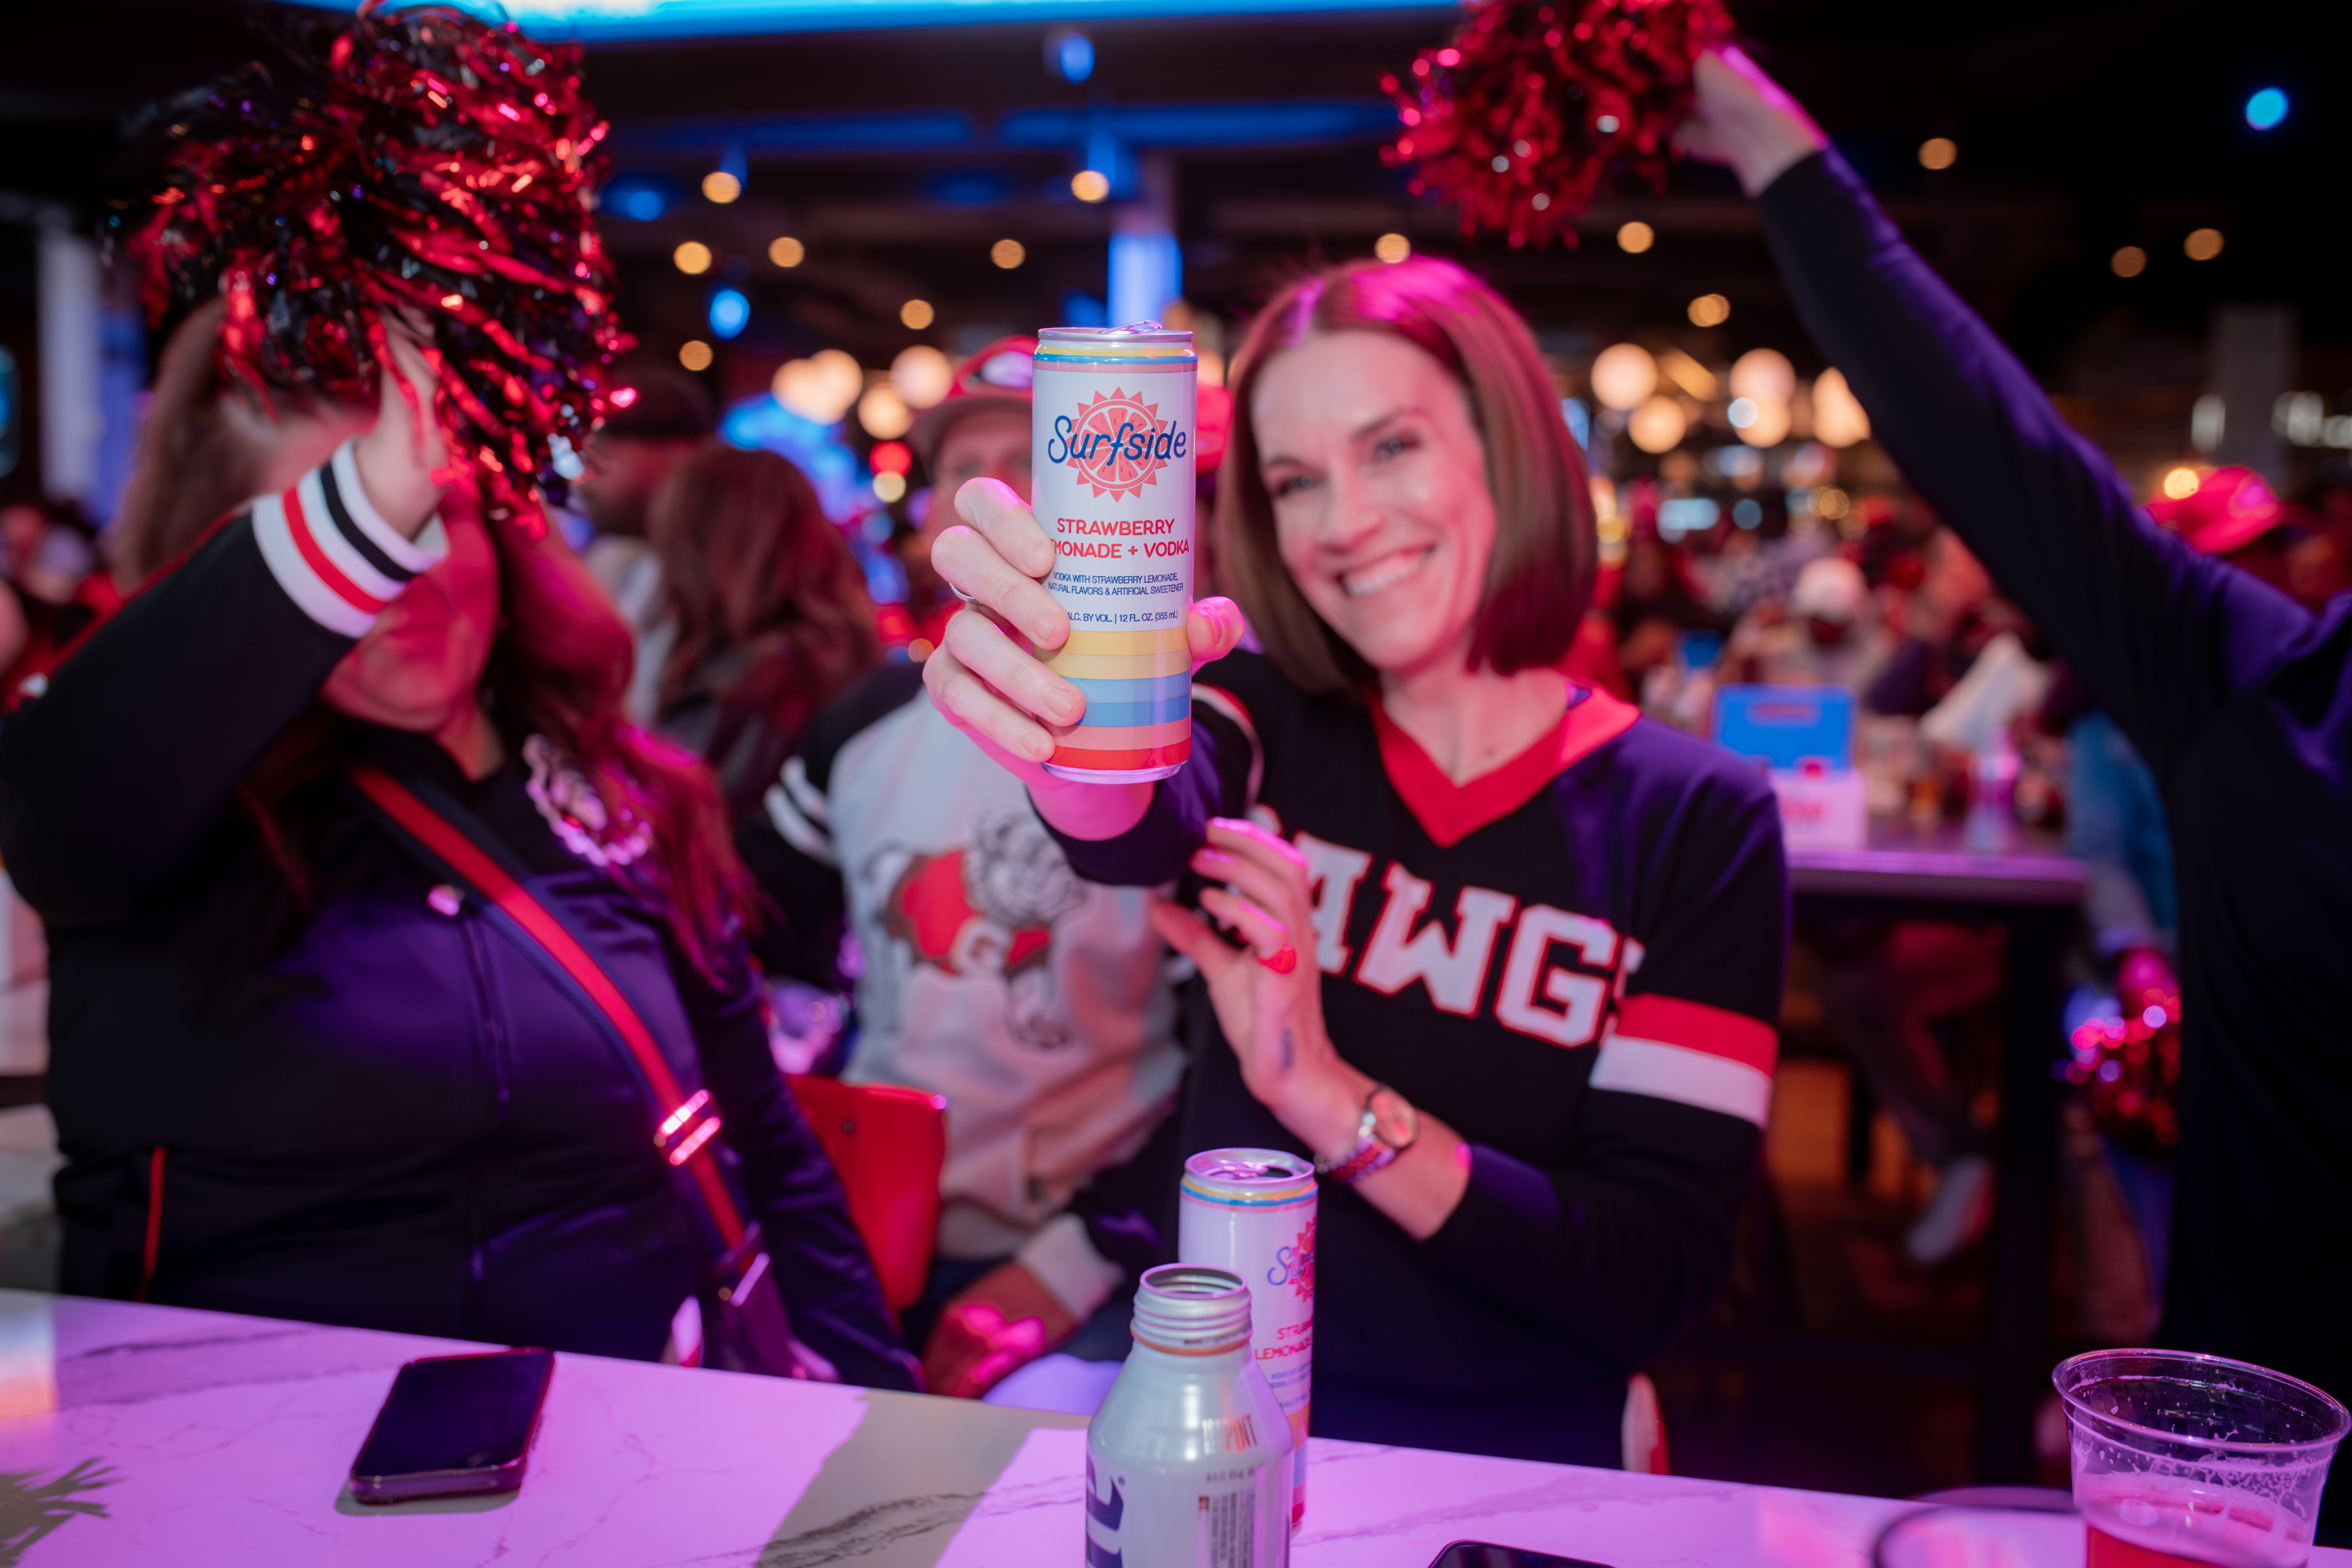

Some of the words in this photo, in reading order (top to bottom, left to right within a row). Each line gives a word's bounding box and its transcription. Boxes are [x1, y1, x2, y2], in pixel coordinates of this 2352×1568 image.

[1048, 415, 1186, 466] Surfside
[1057, 518, 1175, 536] STRAWBERRY
[1050, 539, 1122, 559] MONADE
[1128, 545, 1138, 555] +
[1143, 539, 1189, 558] VODKA
[1053, 572, 1072, 582] VODKA
[1073, 574, 1090, 583] WITH
[1092, 575, 1143, 584] STRAWBERRY
[1144, 572, 1178, 583] LEMONADE,
[1048, 581, 1071, 593] NATURAL
[1072, 586, 1103, 595] FLAVORS
[1111, 587, 1149, 595] ARTIFICIAL
[1151, 583, 1183, 594] SWEETENER
[1083, 613, 1094, 621] BY
[1155, 612, 1168, 622] (355
[1169, 610, 1178, 619] mL)
